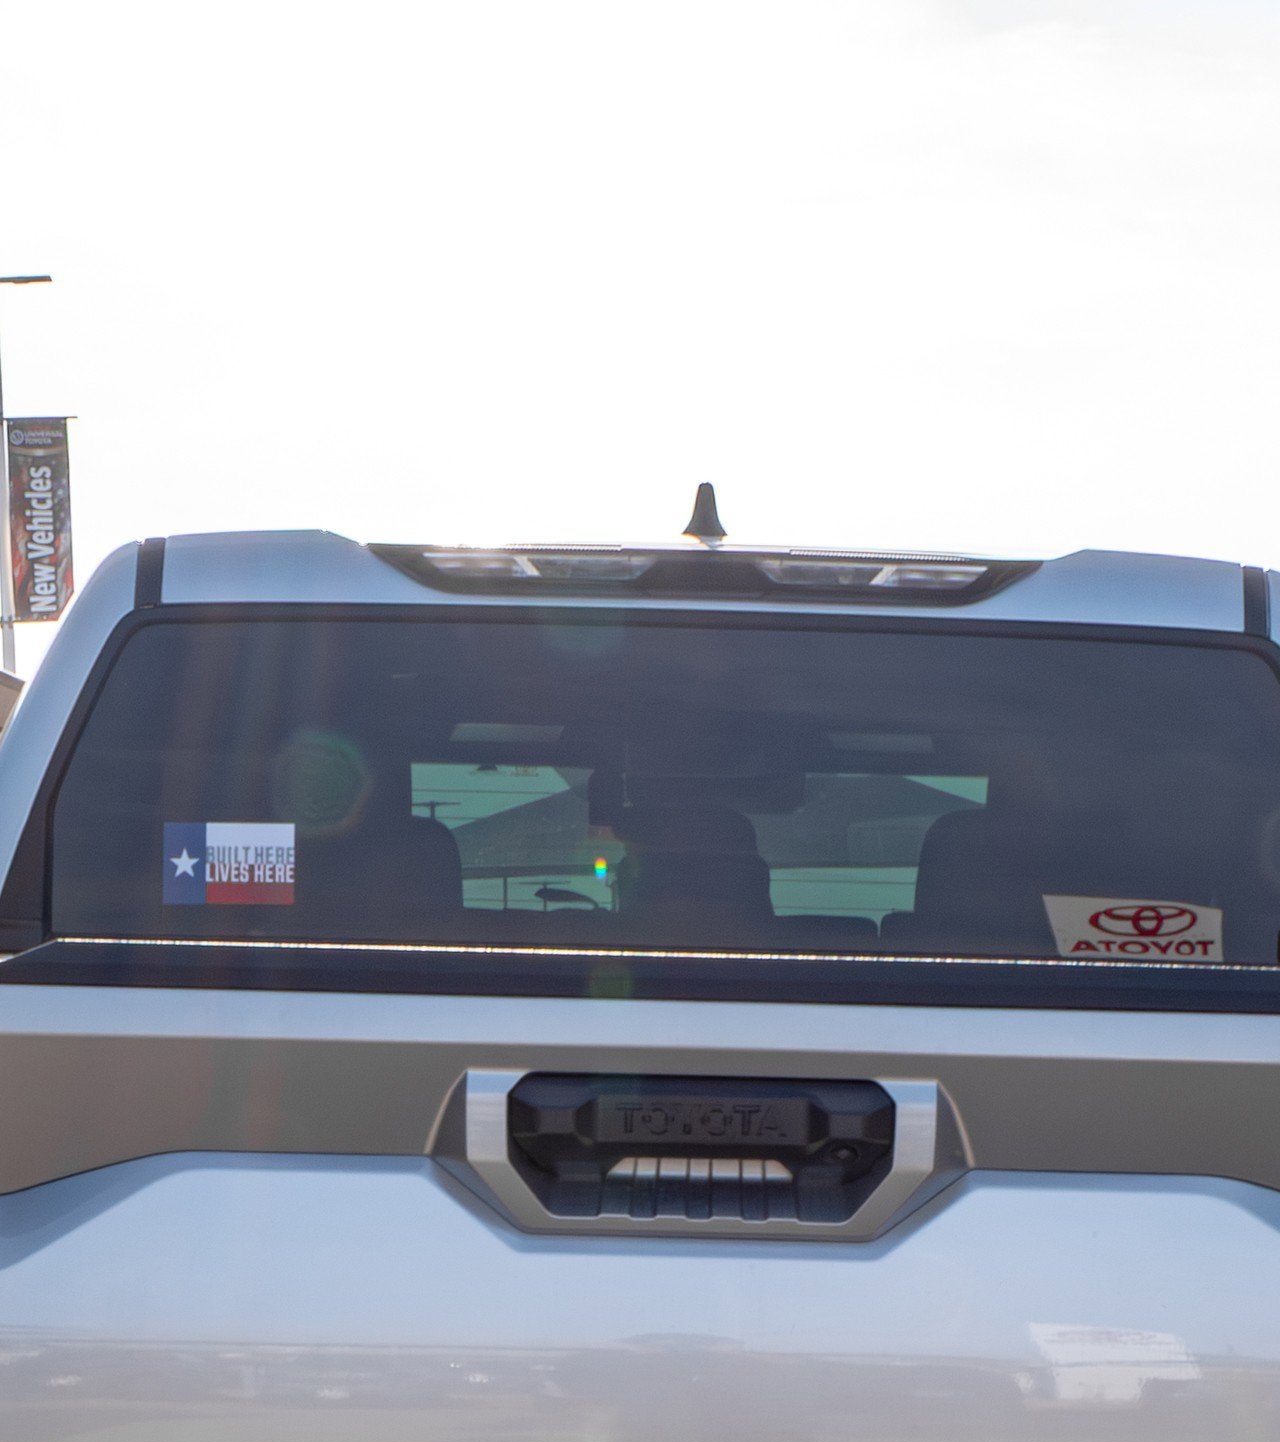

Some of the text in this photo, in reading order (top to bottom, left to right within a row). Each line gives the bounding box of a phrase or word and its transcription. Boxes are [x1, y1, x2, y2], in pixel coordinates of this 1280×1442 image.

[24, 465, 54, 559] Vehicles
[29, 564, 57, 613] New
[206, 846, 295, 864] BUILT HERE
[206, 864, 295, 883] LIVES HERE
[617, 1102, 787, 1138] TOYOTA
